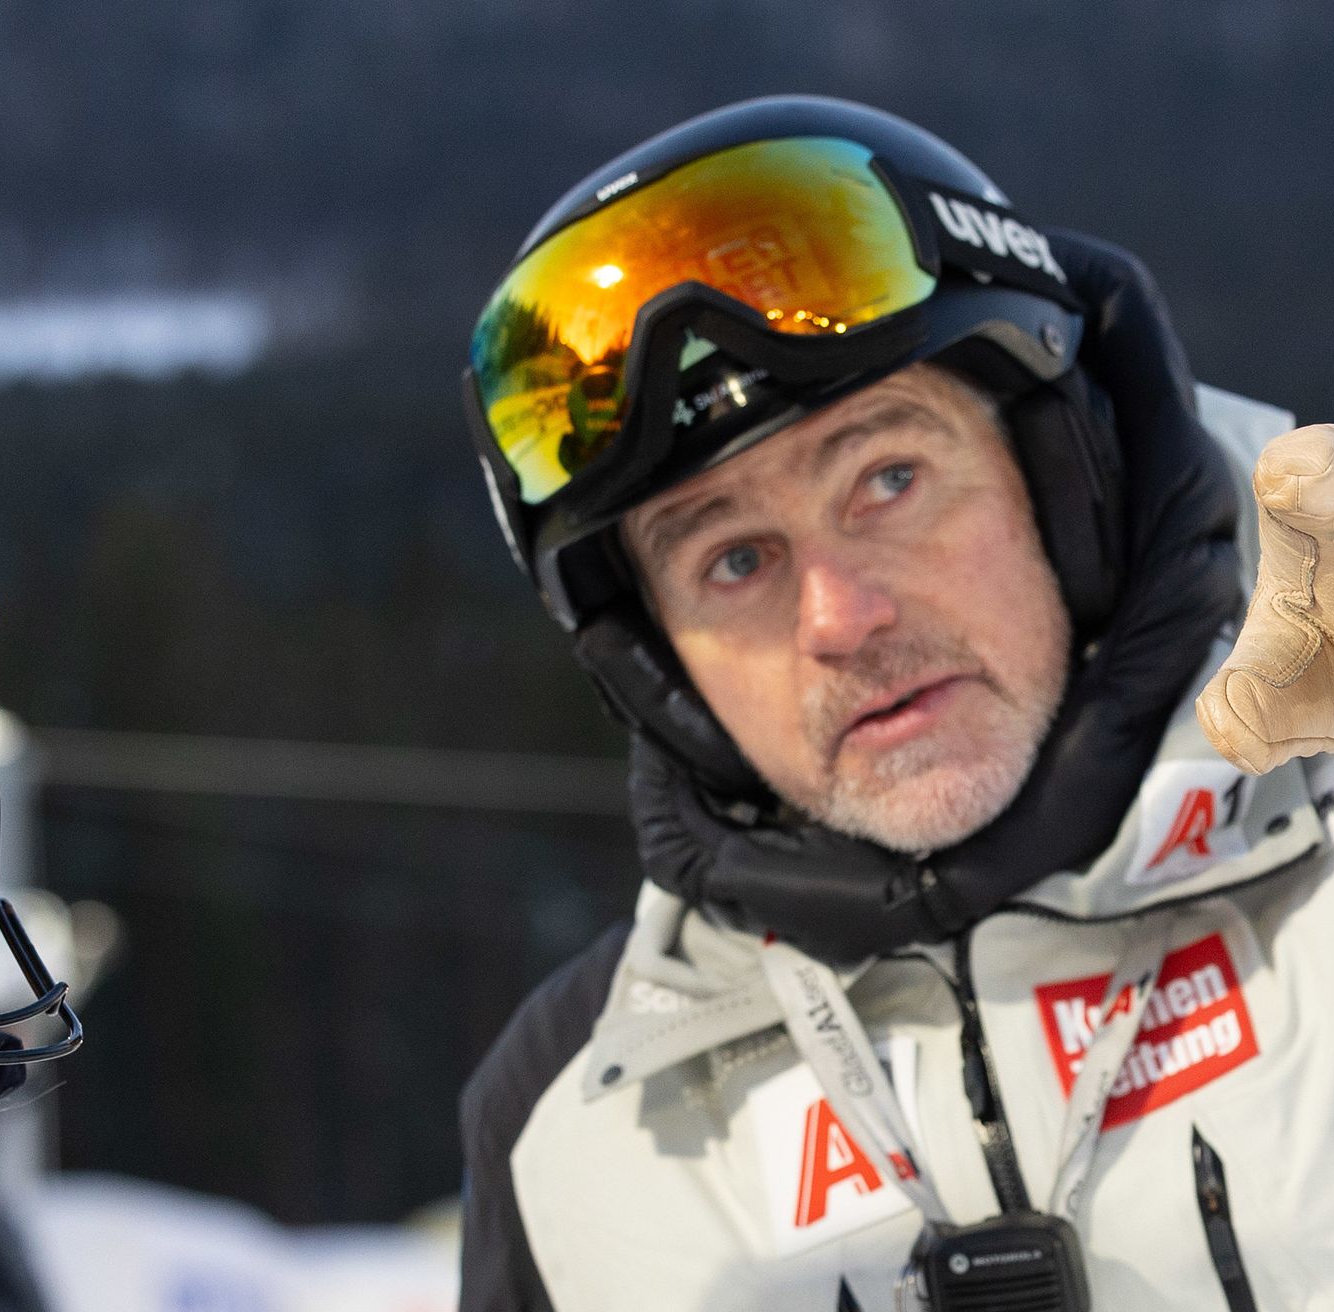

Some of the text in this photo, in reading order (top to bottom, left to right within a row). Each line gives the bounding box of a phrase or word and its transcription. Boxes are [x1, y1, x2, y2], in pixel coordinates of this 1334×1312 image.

[929, 192, 1067, 284] uvex
[1146, 774, 1244, 869] A1
[1069, 1007, 1243, 1099] eitung
[794, 1097, 893, 1228] A
